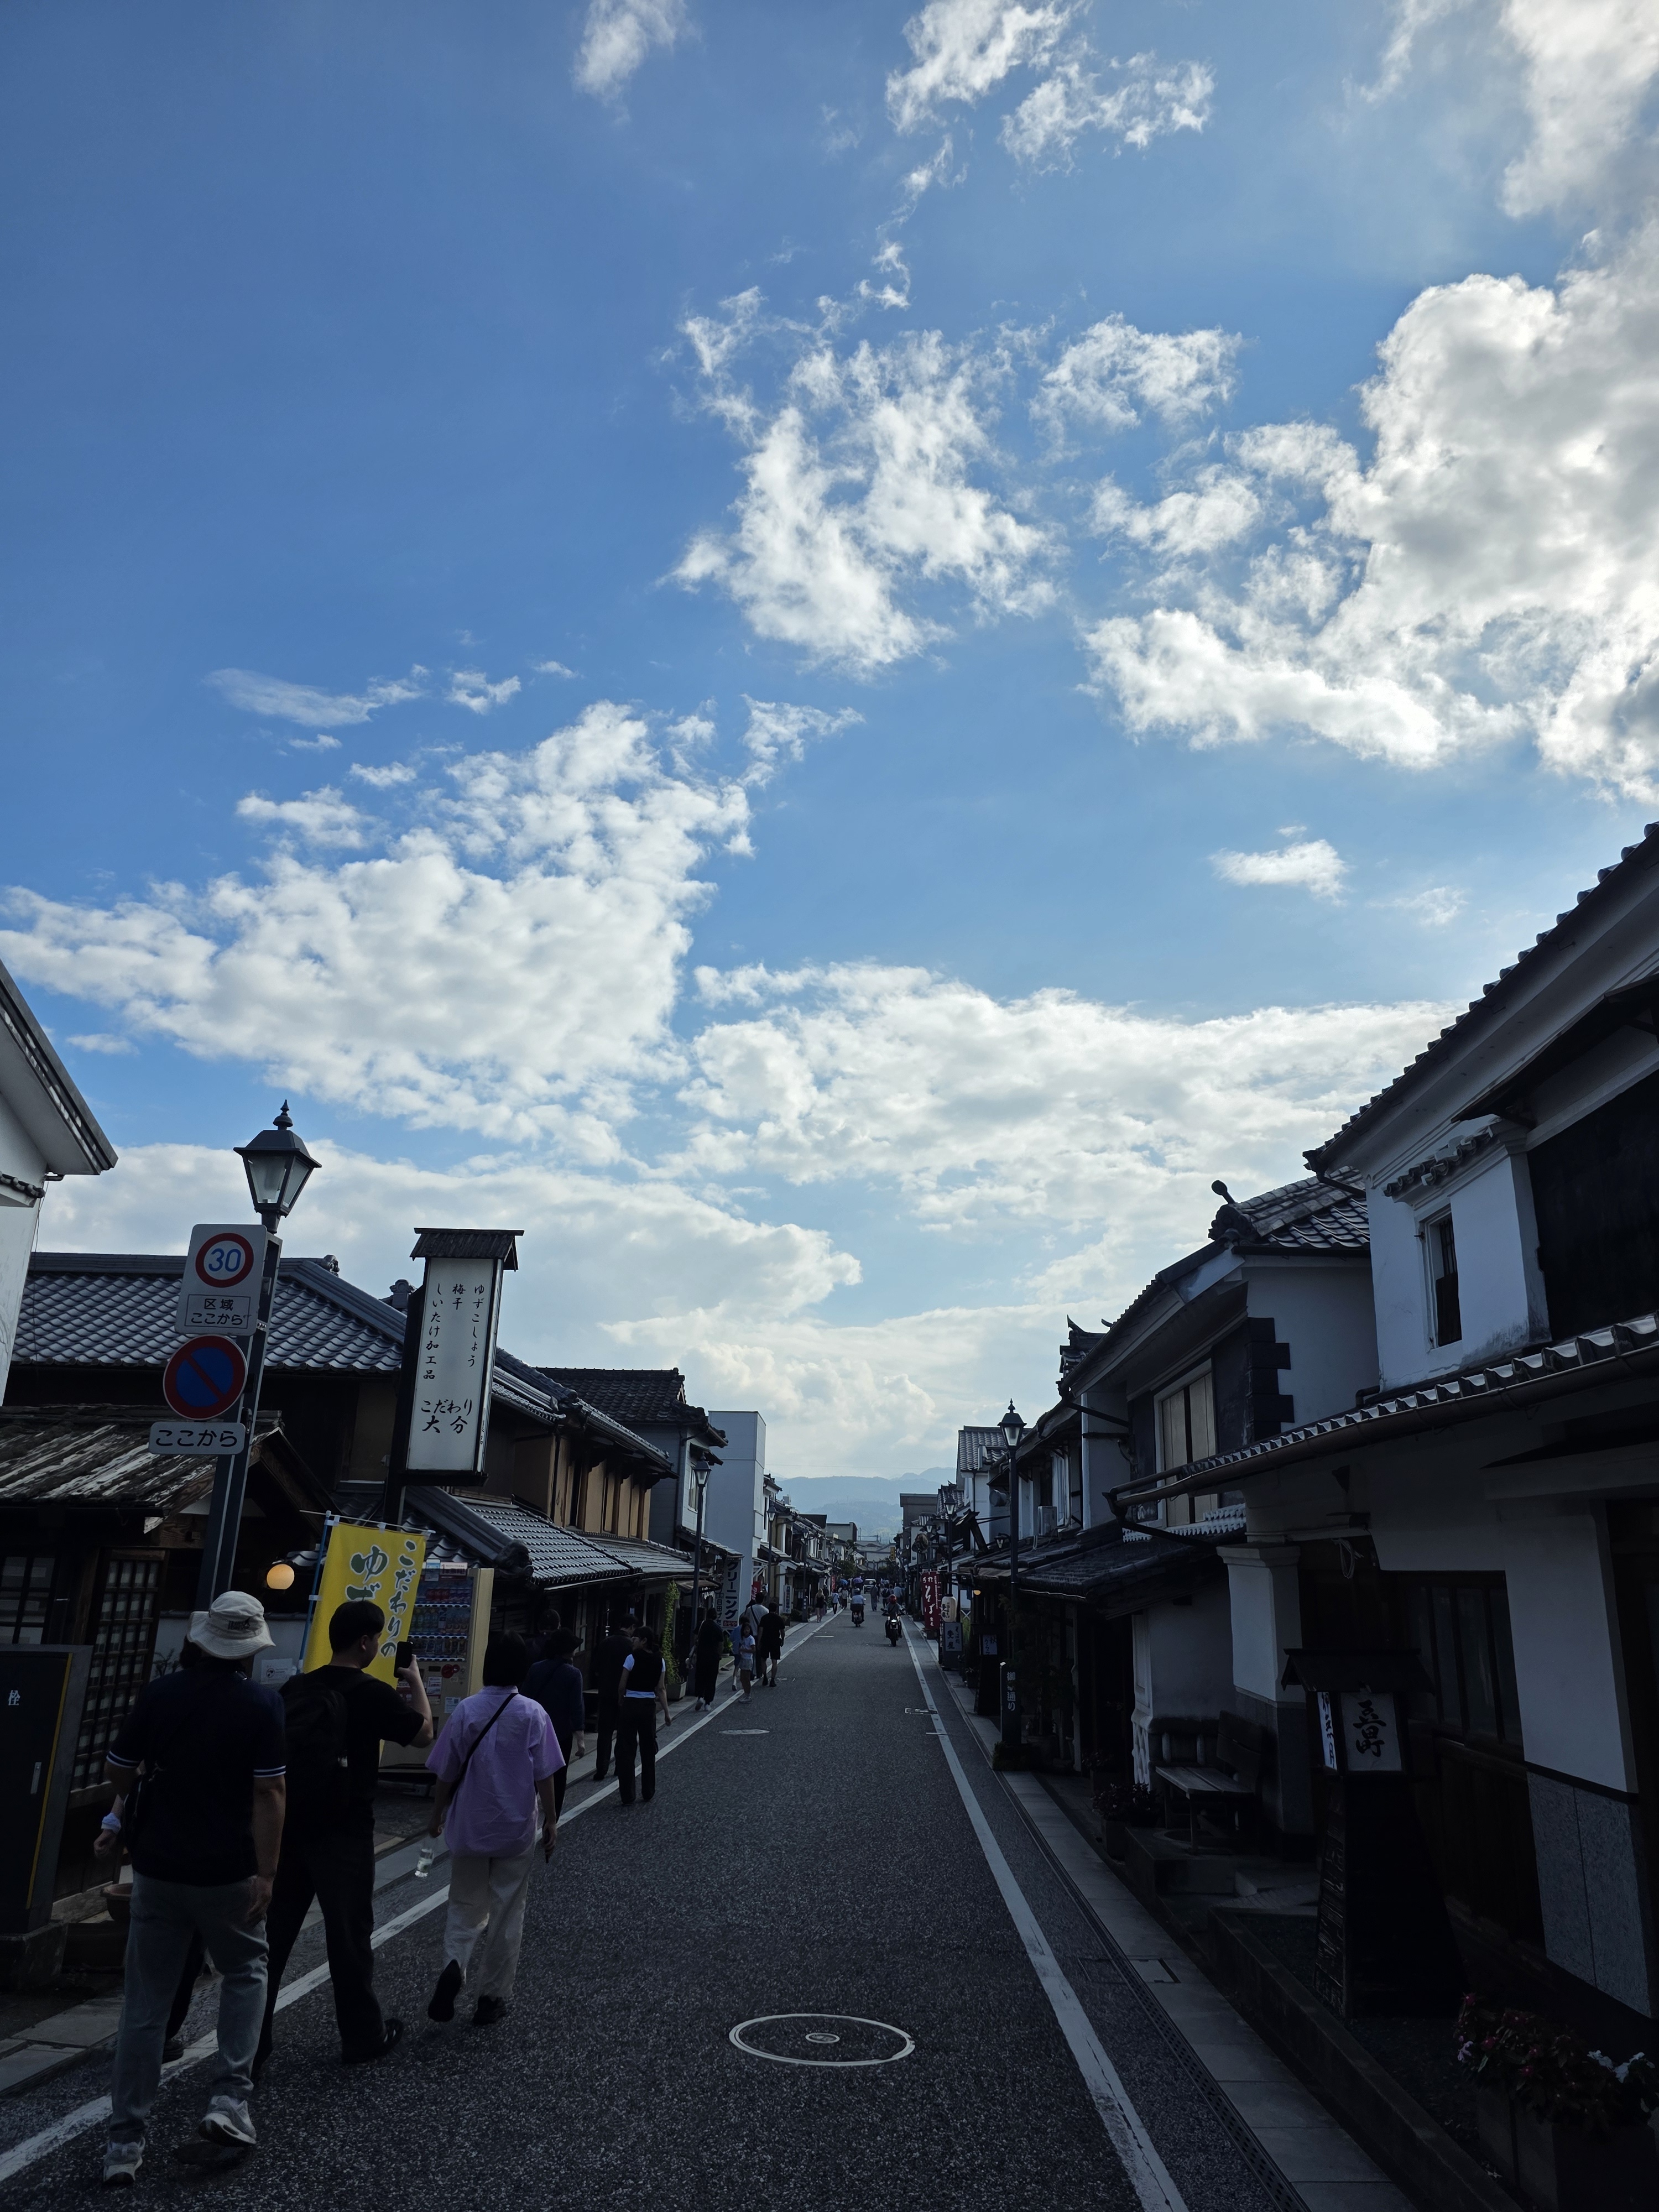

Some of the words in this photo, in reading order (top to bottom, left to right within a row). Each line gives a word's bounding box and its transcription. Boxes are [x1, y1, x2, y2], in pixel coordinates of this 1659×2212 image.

[208, 1248, 241, 1272] 30
[205, 1298, 233, 1311] 区域
[452, 1284, 466, 1310] 梅干
[191, 1313, 243, 1325] ここから
[468, 1284, 484, 1367] ゆずこしょう
[423, 1283, 443, 1380] しいたけ加工品
[421, 1399, 472, 1415] こだわり
[422, 1415, 468, 1433] 大分
[156, 1430, 237, 1447] ここから
[380, 1540, 416, 1657] こだわりの
[725, 1561, 738, 1620] クリーニング
[8, 1689, 20, 1706] 栓
